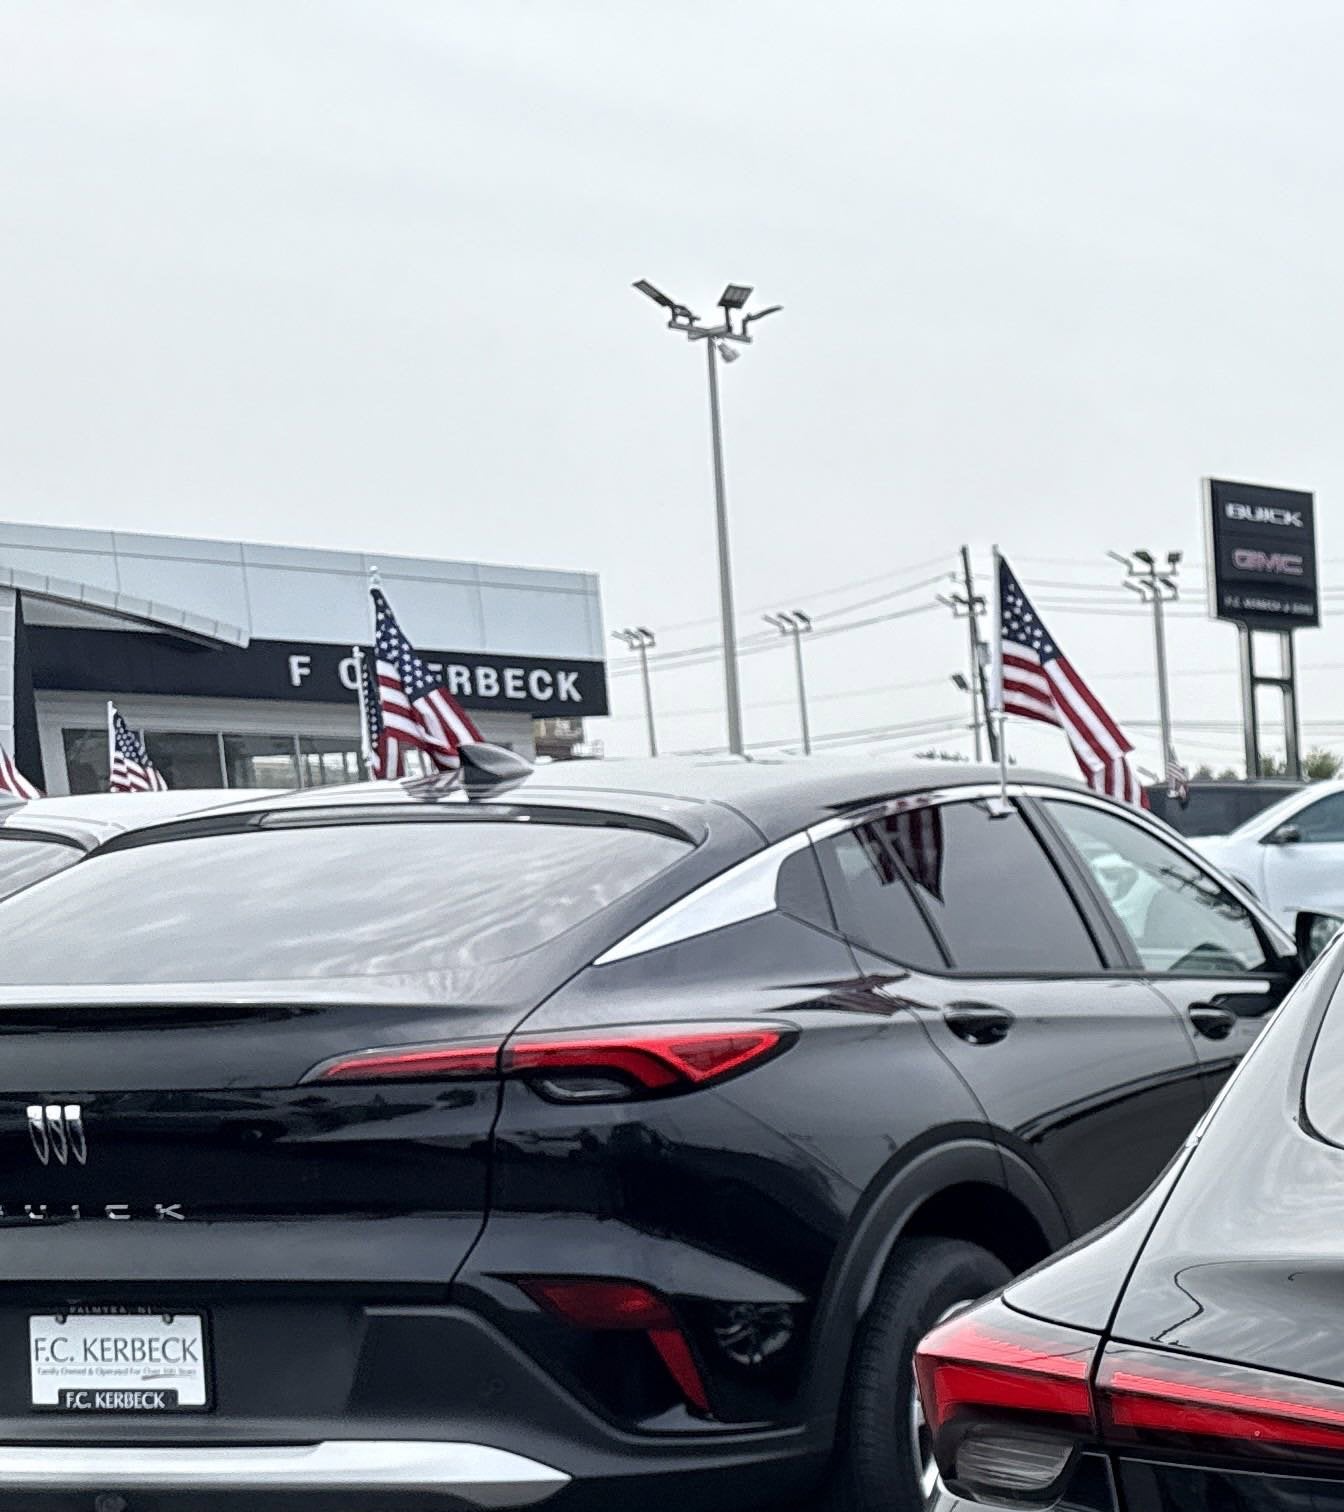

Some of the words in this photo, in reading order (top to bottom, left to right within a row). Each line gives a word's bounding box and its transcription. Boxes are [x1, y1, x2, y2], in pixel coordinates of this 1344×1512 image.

[1225, 503, 1304, 527] BUICK
[1233, 549, 1303, 575] GMC
[288, 655, 311, 687] F
[422, 662, 582, 703] RBECK
[0, 1204, 185, 1220] UICK
[34, 1337, 75, 1362] F.C.
[83, 1337, 198, 1363] KERBECK
[66, 1392, 91, 1408] F.C.
[95, 1391, 165, 1409] KERBECK
